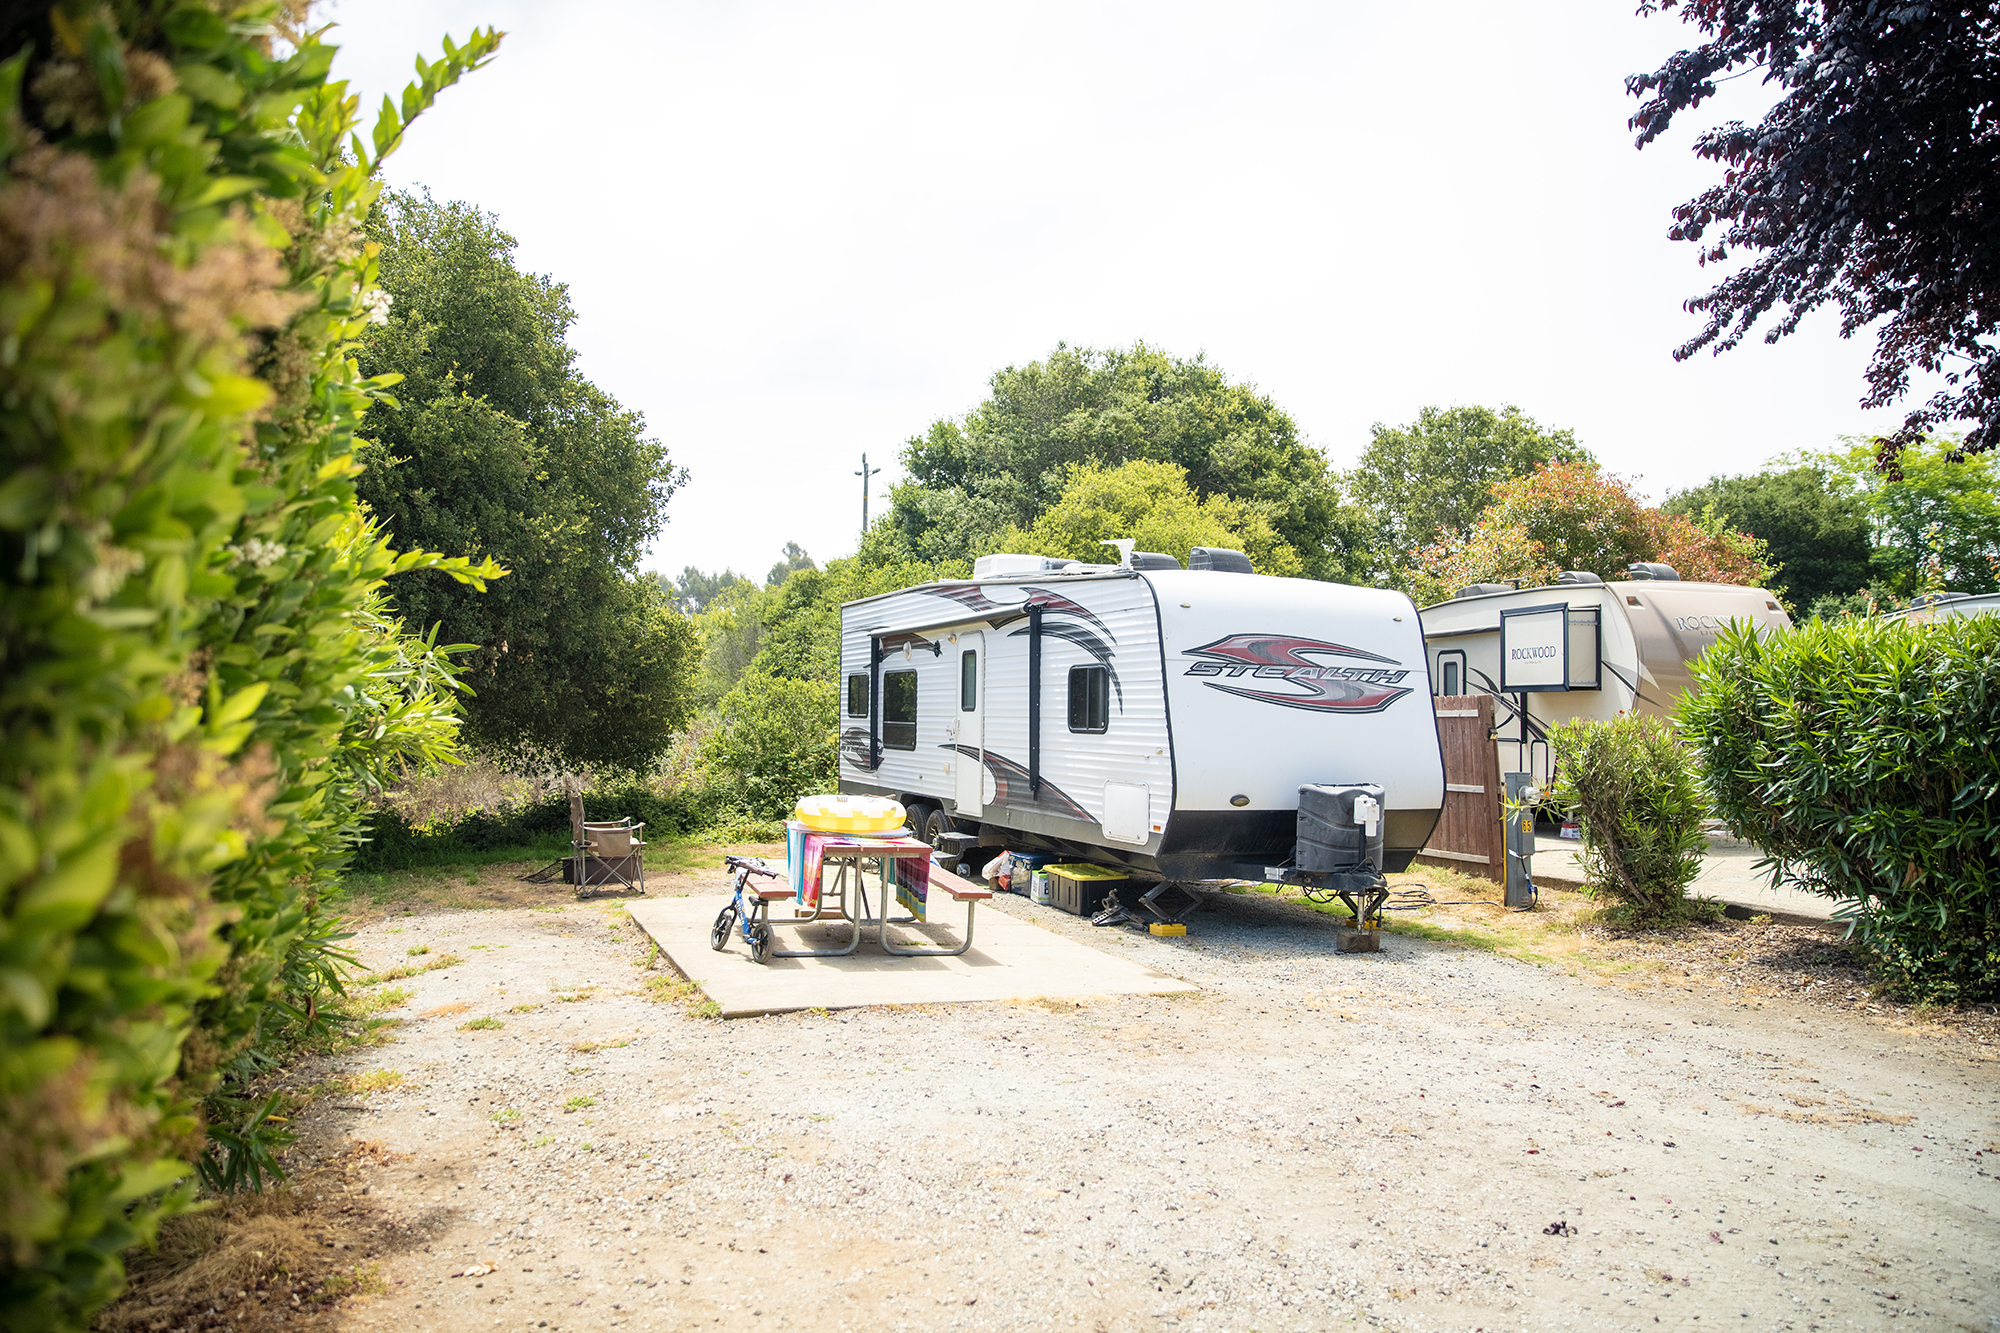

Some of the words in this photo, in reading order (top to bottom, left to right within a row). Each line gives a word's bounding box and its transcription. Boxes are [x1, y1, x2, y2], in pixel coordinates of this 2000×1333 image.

[1511, 645, 1557, 660] ROCKWOOD
[1184, 661, 1411, 684] STEALTH
[1522, 820, 1532, 832] 65
